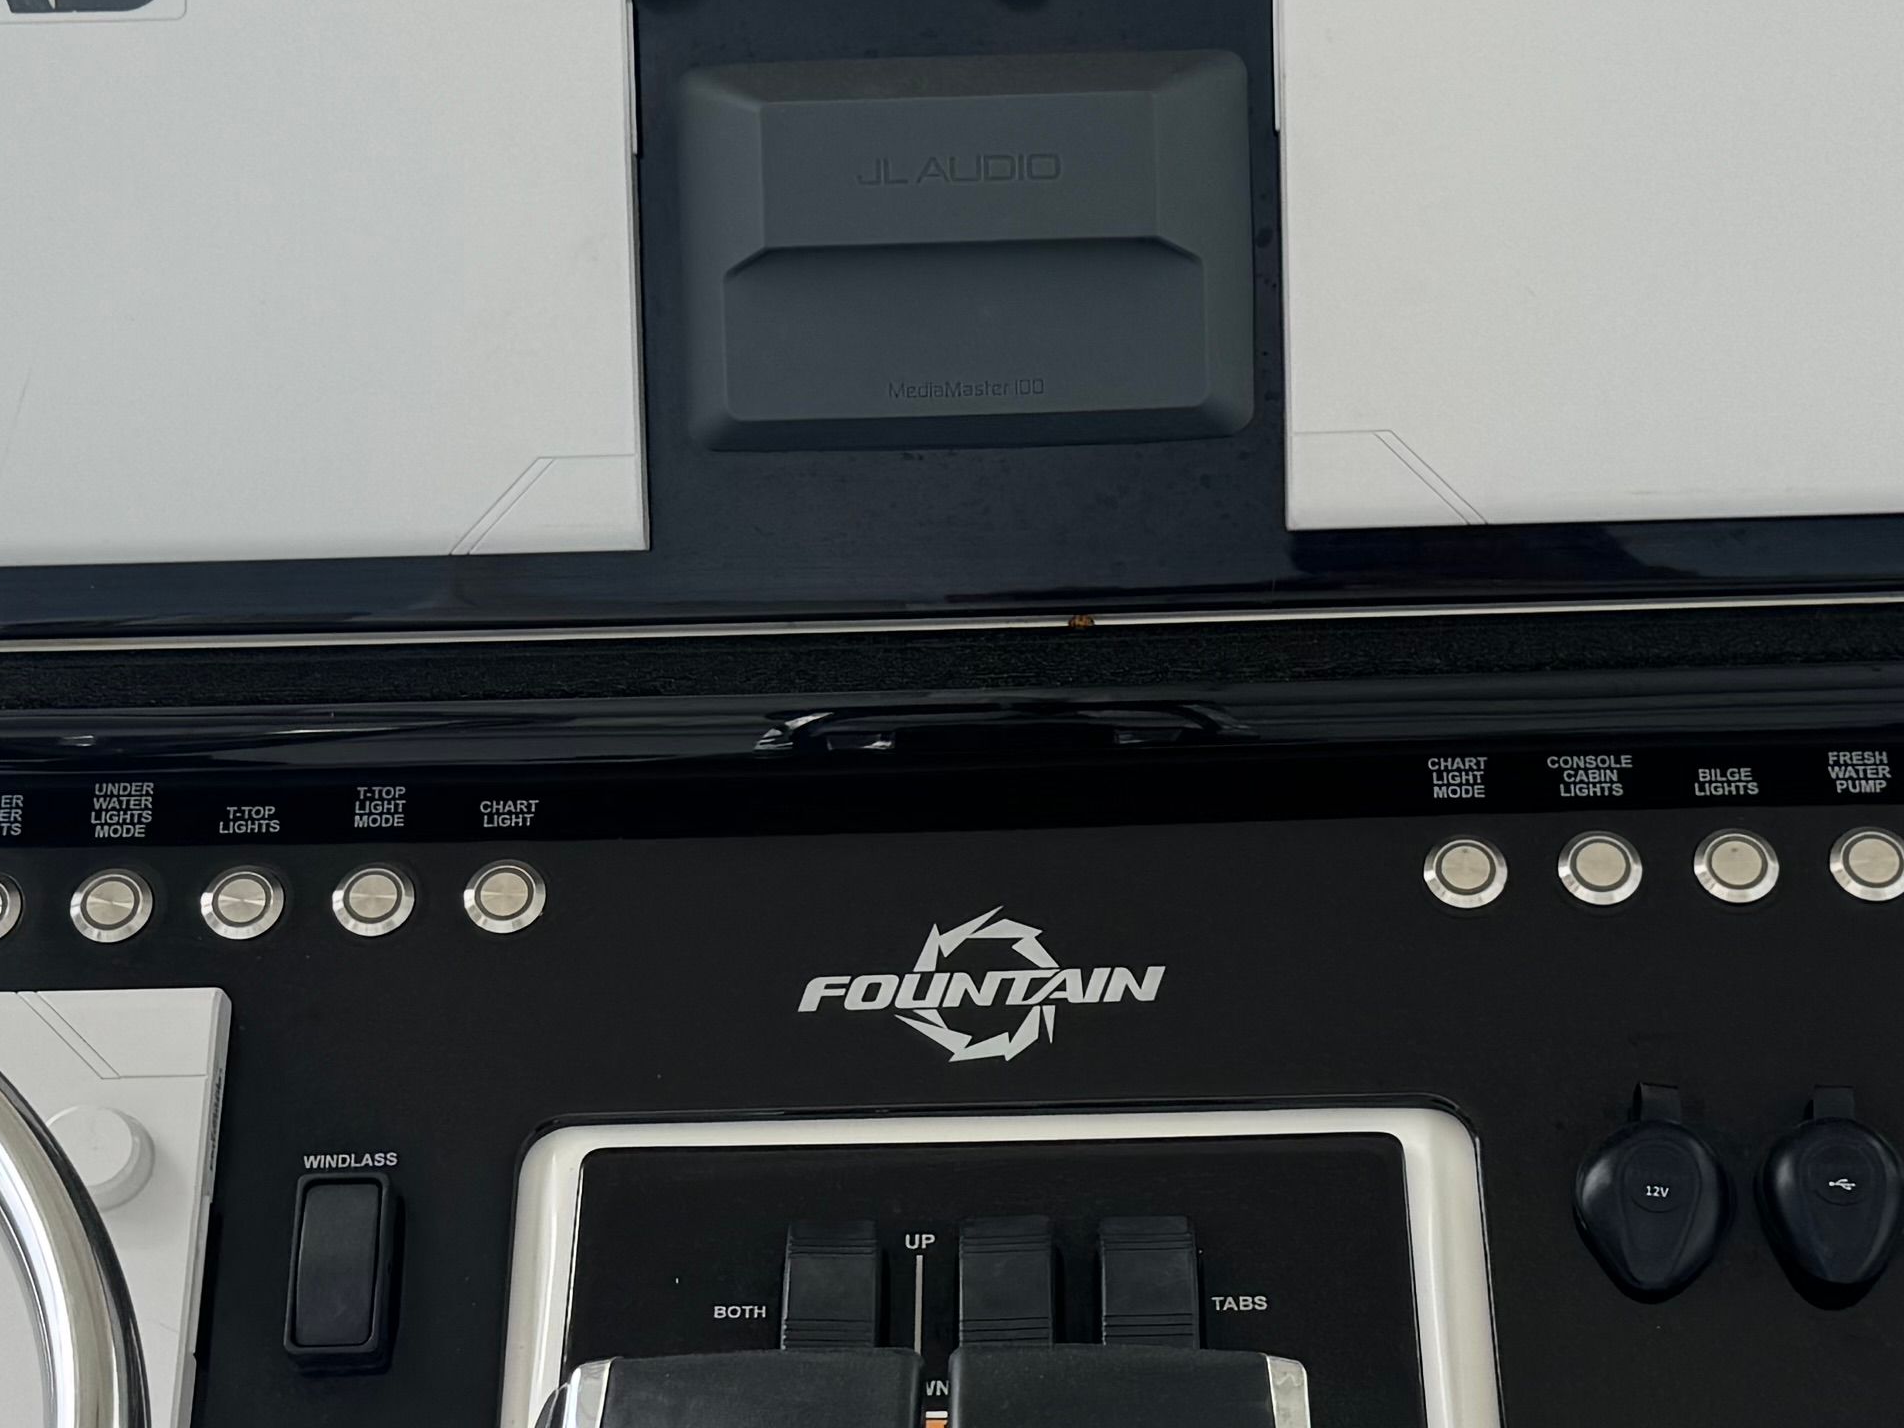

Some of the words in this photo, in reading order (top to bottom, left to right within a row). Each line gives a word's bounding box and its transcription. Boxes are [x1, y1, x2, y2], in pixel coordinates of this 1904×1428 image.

[857, 158, 908, 186] JL
[917, 154, 1061, 184] AUDIO
[888, 380, 1008, 398] MediaMaster
[1428, 757, 1487, 771] CHART
[1547, 755, 1633, 770] CONSOLE
[1828, 751, 1888, 766] FRESH
[1432, 771, 1484, 785] LIGHT
[1563, 769, 1618, 784] CABIN
[1699, 768, 1753, 782] BILGE
[1828, 765, 1891, 780] WATER
[95, 782, 154, 797] UNDER
[357, 786, 406, 800] T-TOP
[1434, 785, 1485, 799] MODE
[1559, 783, 1623, 798] LIGHTS
[1694, 781, 1759, 796] LIGHTS
[1836, 779, 1887, 794] PUMP
[93, 796, 152, 811] WATER
[355, 800, 406, 814] LIGHT
[480, 800, 539, 814] CHART
[90, 810, 152, 825] LIGHTS
[227, 806, 275, 820] T-TOP
[219, 819, 280, 834] LIGHTS
[354, 814, 405, 828] MODE
[483, 814, 534, 828] LIGHT
[95, 824, 146, 838] MODE
[797, 965, 1166, 1012] FOUNTAIN
[303, 1152, 398, 1169] WINDLASS
[1645, 1185, 1670, 1198] 12V
[904, 1233, 936, 1250] UP
[1211, 1296, 1268, 1312] TABS
[713, 1305, 767, 1319] BOTH
